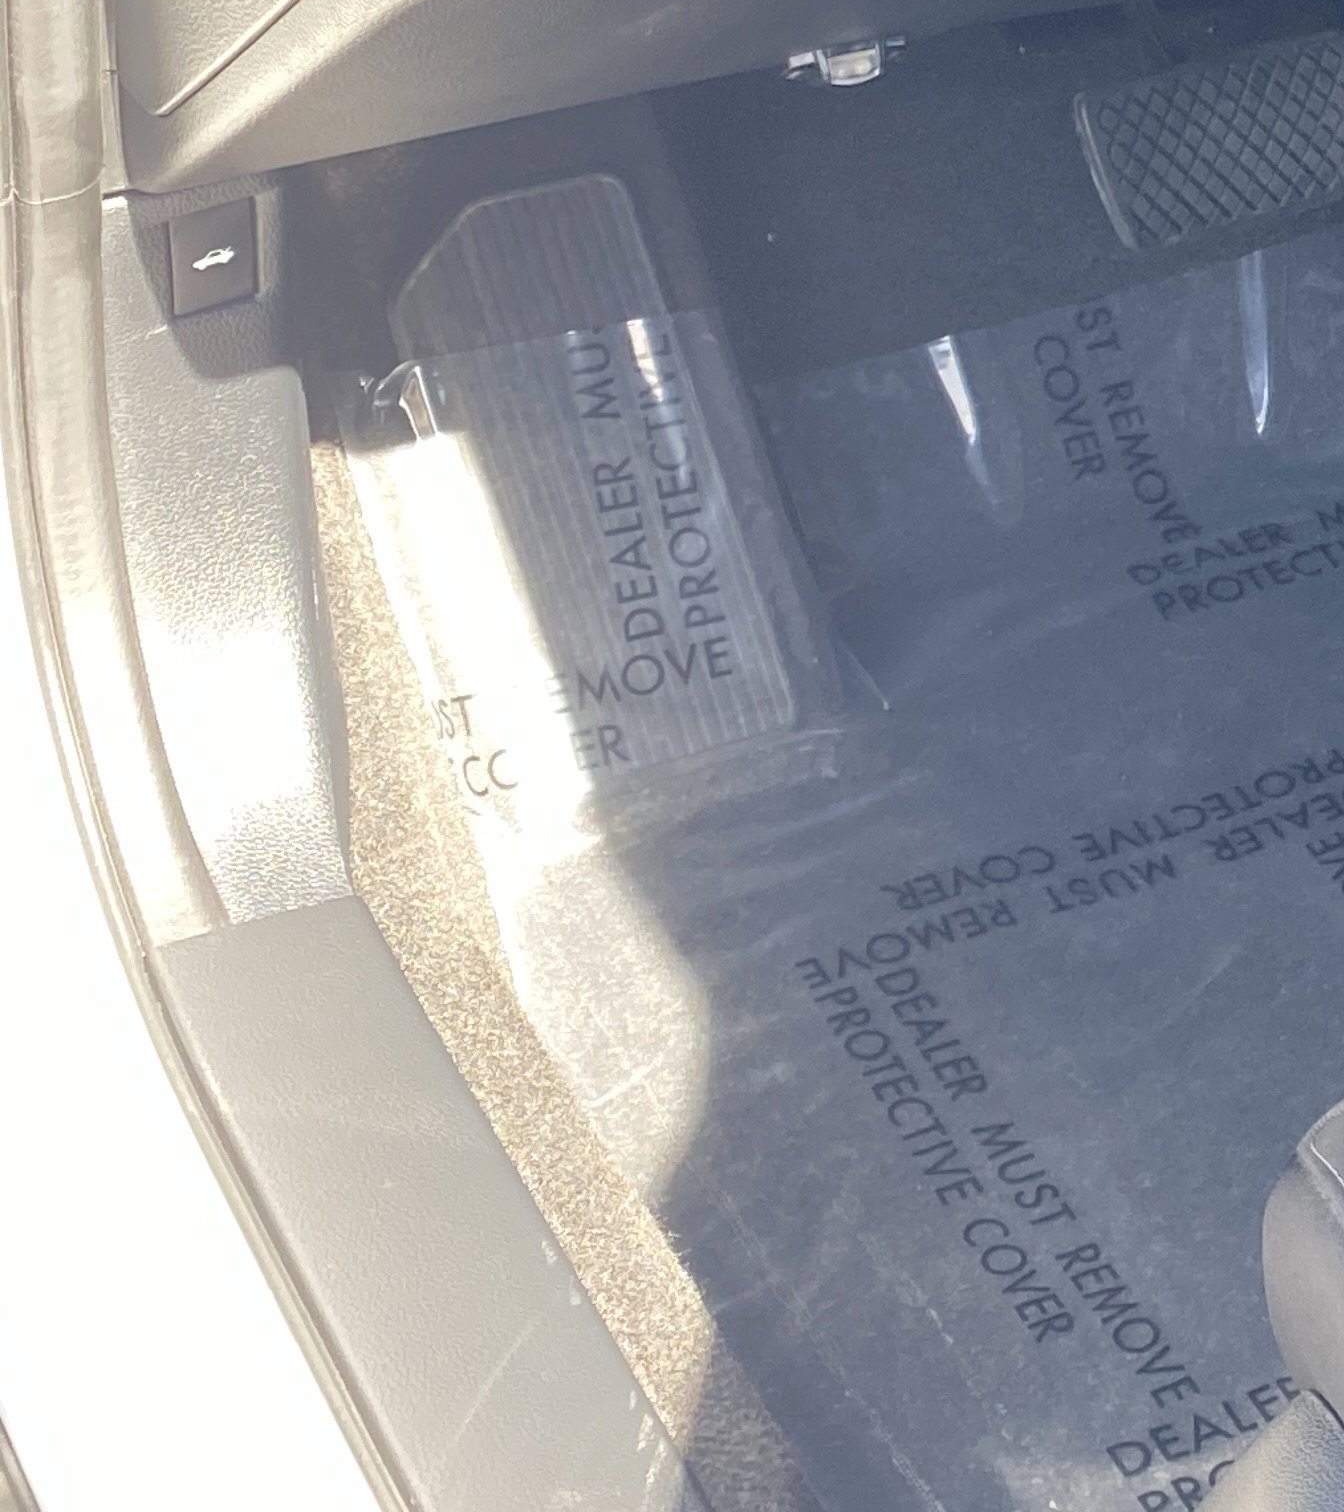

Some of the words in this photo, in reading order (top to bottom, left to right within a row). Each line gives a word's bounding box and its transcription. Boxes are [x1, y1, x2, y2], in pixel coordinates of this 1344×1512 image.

[1034, 335, 1106, 480] COVER
[1100, 380, 1203, 543] REMOVE
[593, 456, 665, 643] DEALER
[1127, 522, 1292, 588] DEALER
[879, 846, 1055, 911] COVER
[1045, 854, 1177, 913] MUST
[814, 986, 985, 1206] PROTECTIVE
[961, 1217, 1075, 1345] COVER
[874, 968, 989, 1103] DEALER
[971, 1121, 1076, 1226] MUST
[1055, 1242, 1201, 1409] REMOVE
